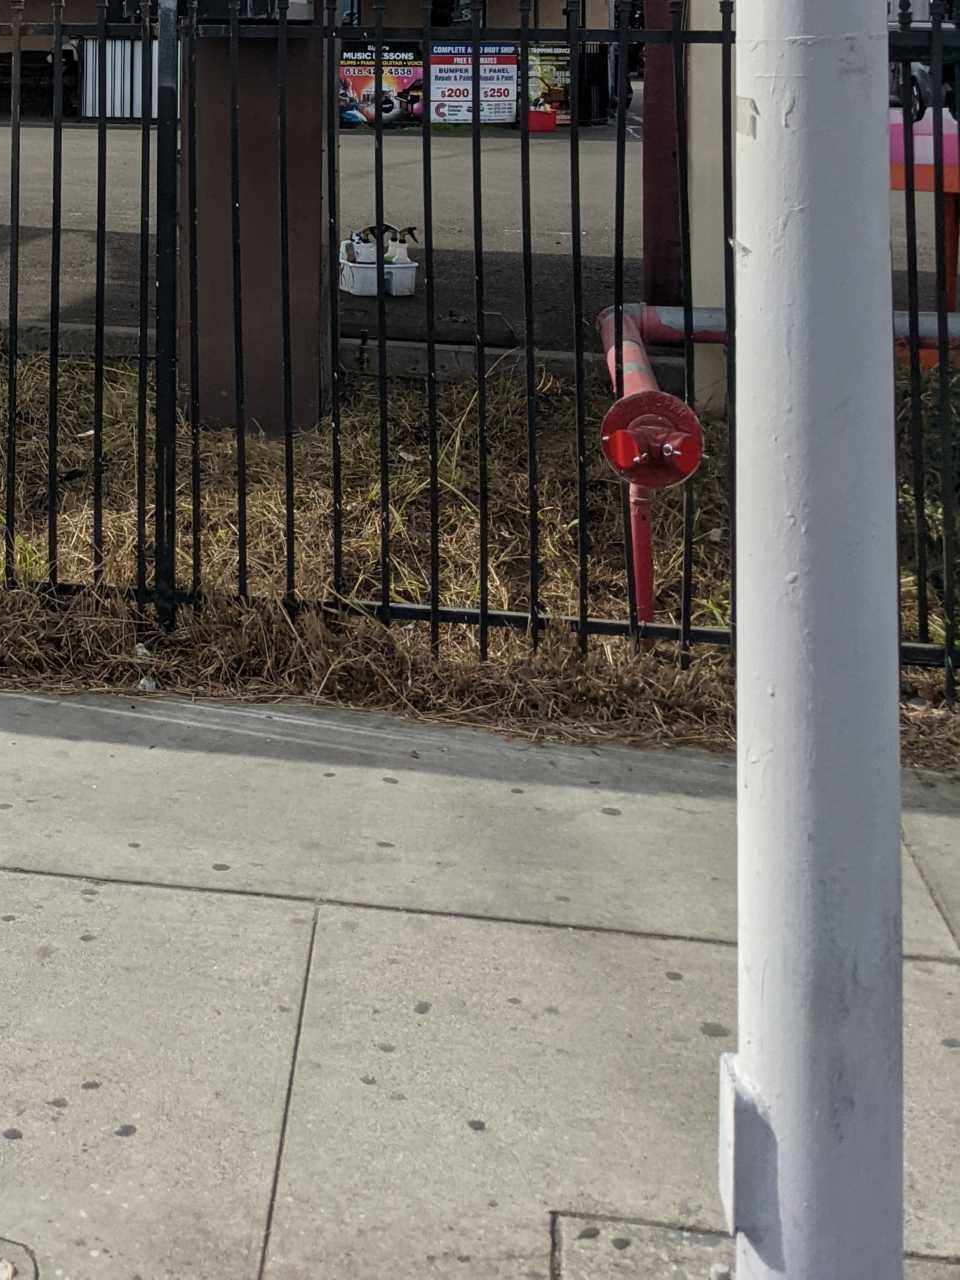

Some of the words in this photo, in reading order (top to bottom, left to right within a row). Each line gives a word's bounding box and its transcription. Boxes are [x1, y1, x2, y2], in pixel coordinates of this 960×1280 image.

[433, 45, 467, 54] COMPLETE
[343, 52, 371, 60] MUSIC
[372, 52, 414, 60] LSSONS
[441, 87, 470, 98] $200
[483, 87, 510, 98] $250
